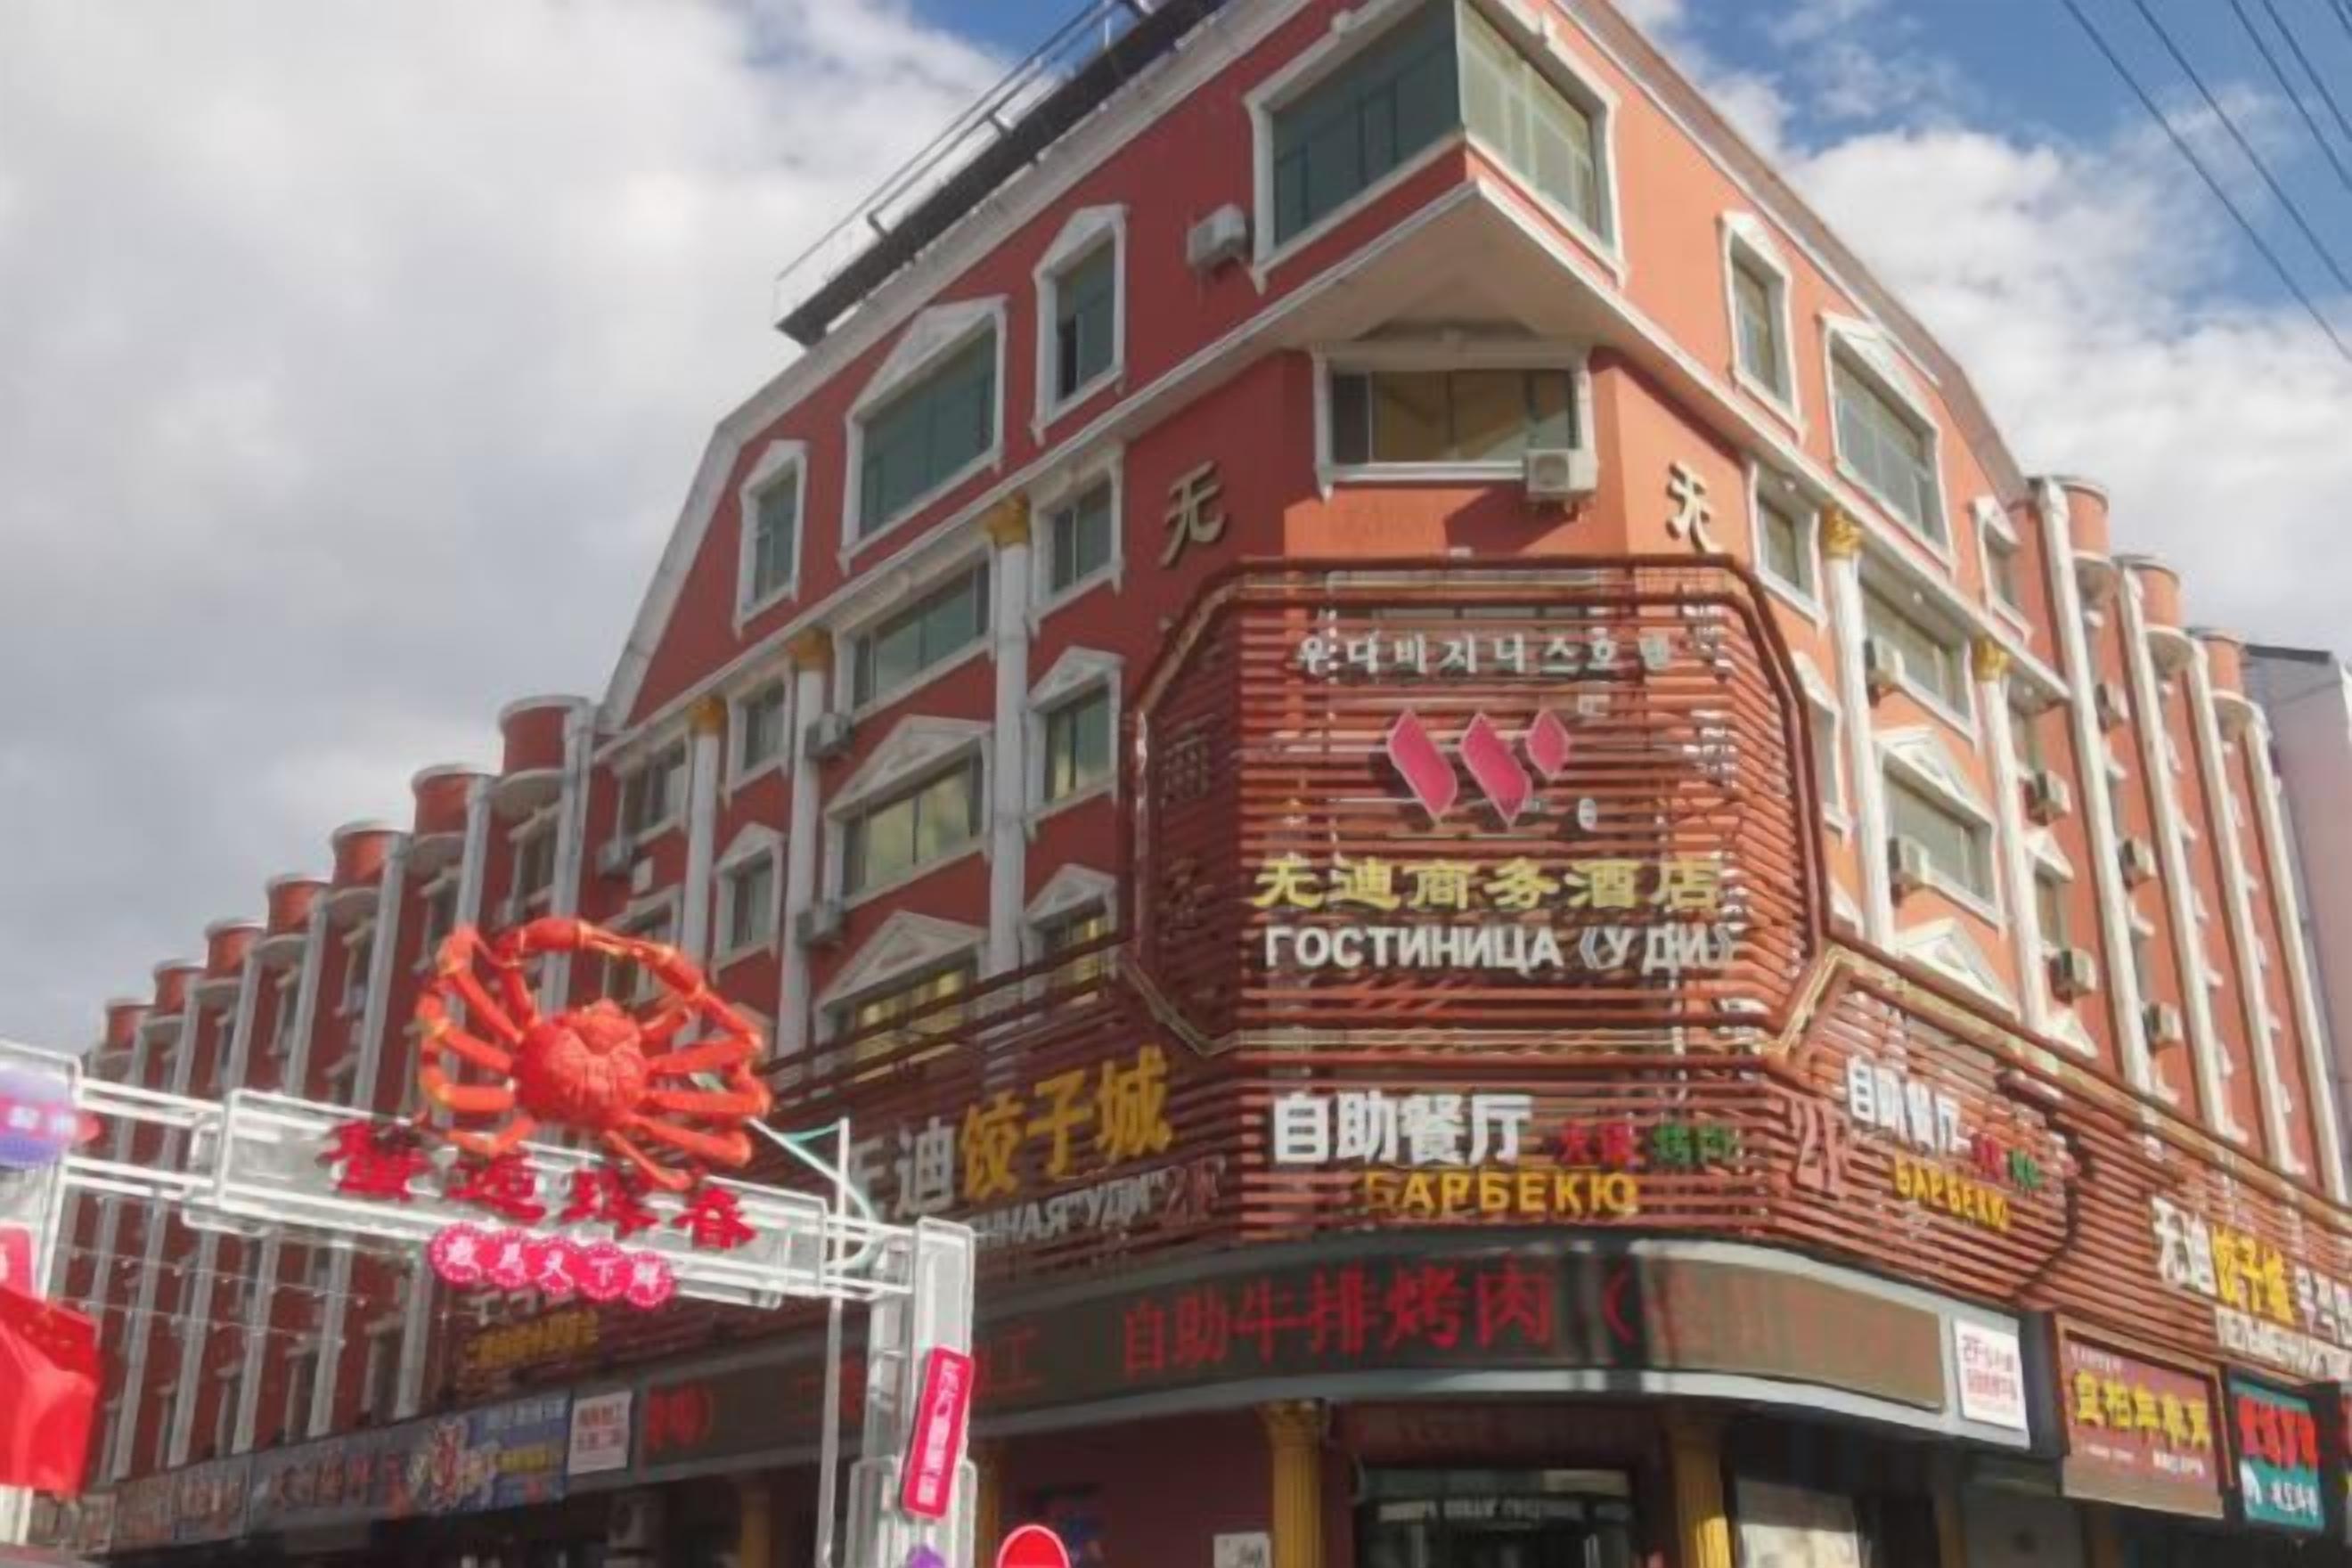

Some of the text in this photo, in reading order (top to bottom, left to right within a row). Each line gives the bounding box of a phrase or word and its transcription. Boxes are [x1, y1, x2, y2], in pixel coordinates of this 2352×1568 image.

[1158, 460, 1226, 568] 无
[1253, 853, 1719, 911] 无迪商务酒店
[1265, 925, 1564, 975] ГОСТИНИЦА
[1274, 1089, 1532, 1165] 自助餐厅
[1366, 1170, 1637, 1217] БАРБЕКЮ
